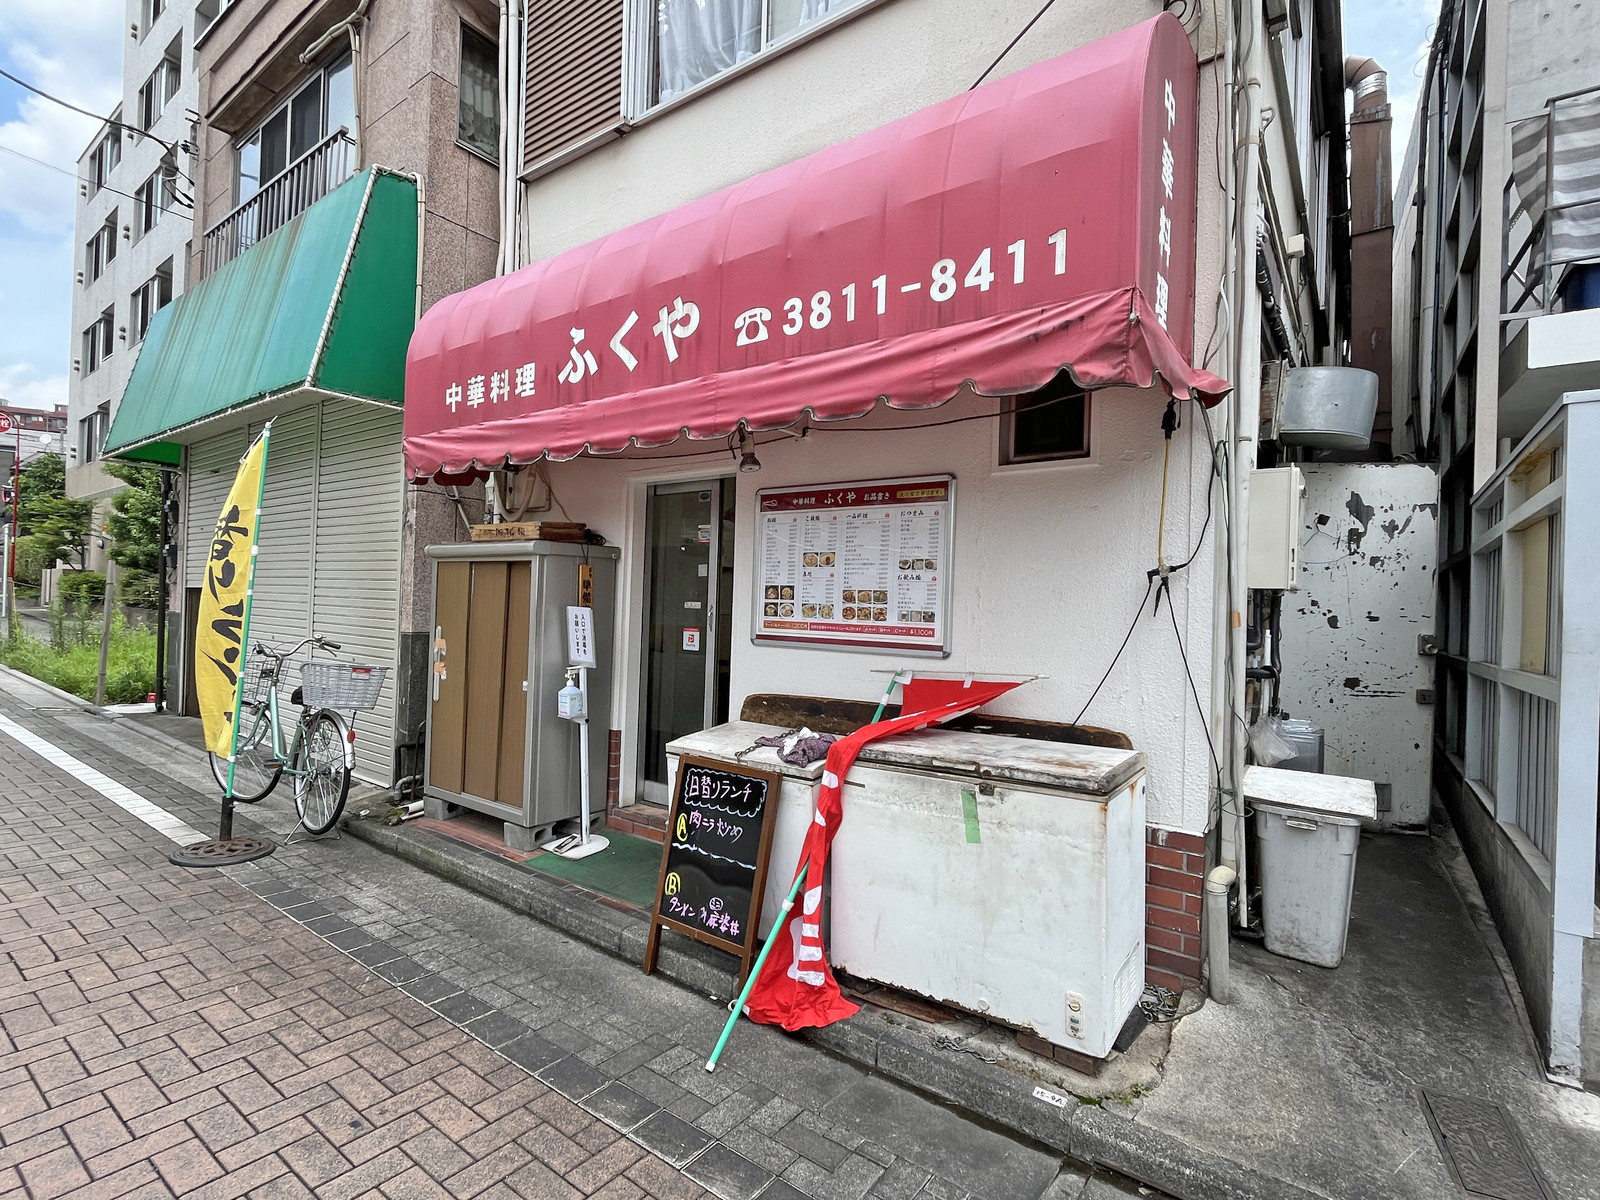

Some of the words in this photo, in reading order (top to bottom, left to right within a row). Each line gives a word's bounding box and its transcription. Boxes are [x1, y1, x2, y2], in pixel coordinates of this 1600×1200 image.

[445, 361, 536, 413] 中華料理
[557, 297, 701, 386] ふくや
[782, 229, 1068, 337] 3811-8411
[824, 491, 856, 505] ふくや
[688, 775, 753, 803] 日替りランチ
[689, 811, 744, 843] 肉ニラ炒め
